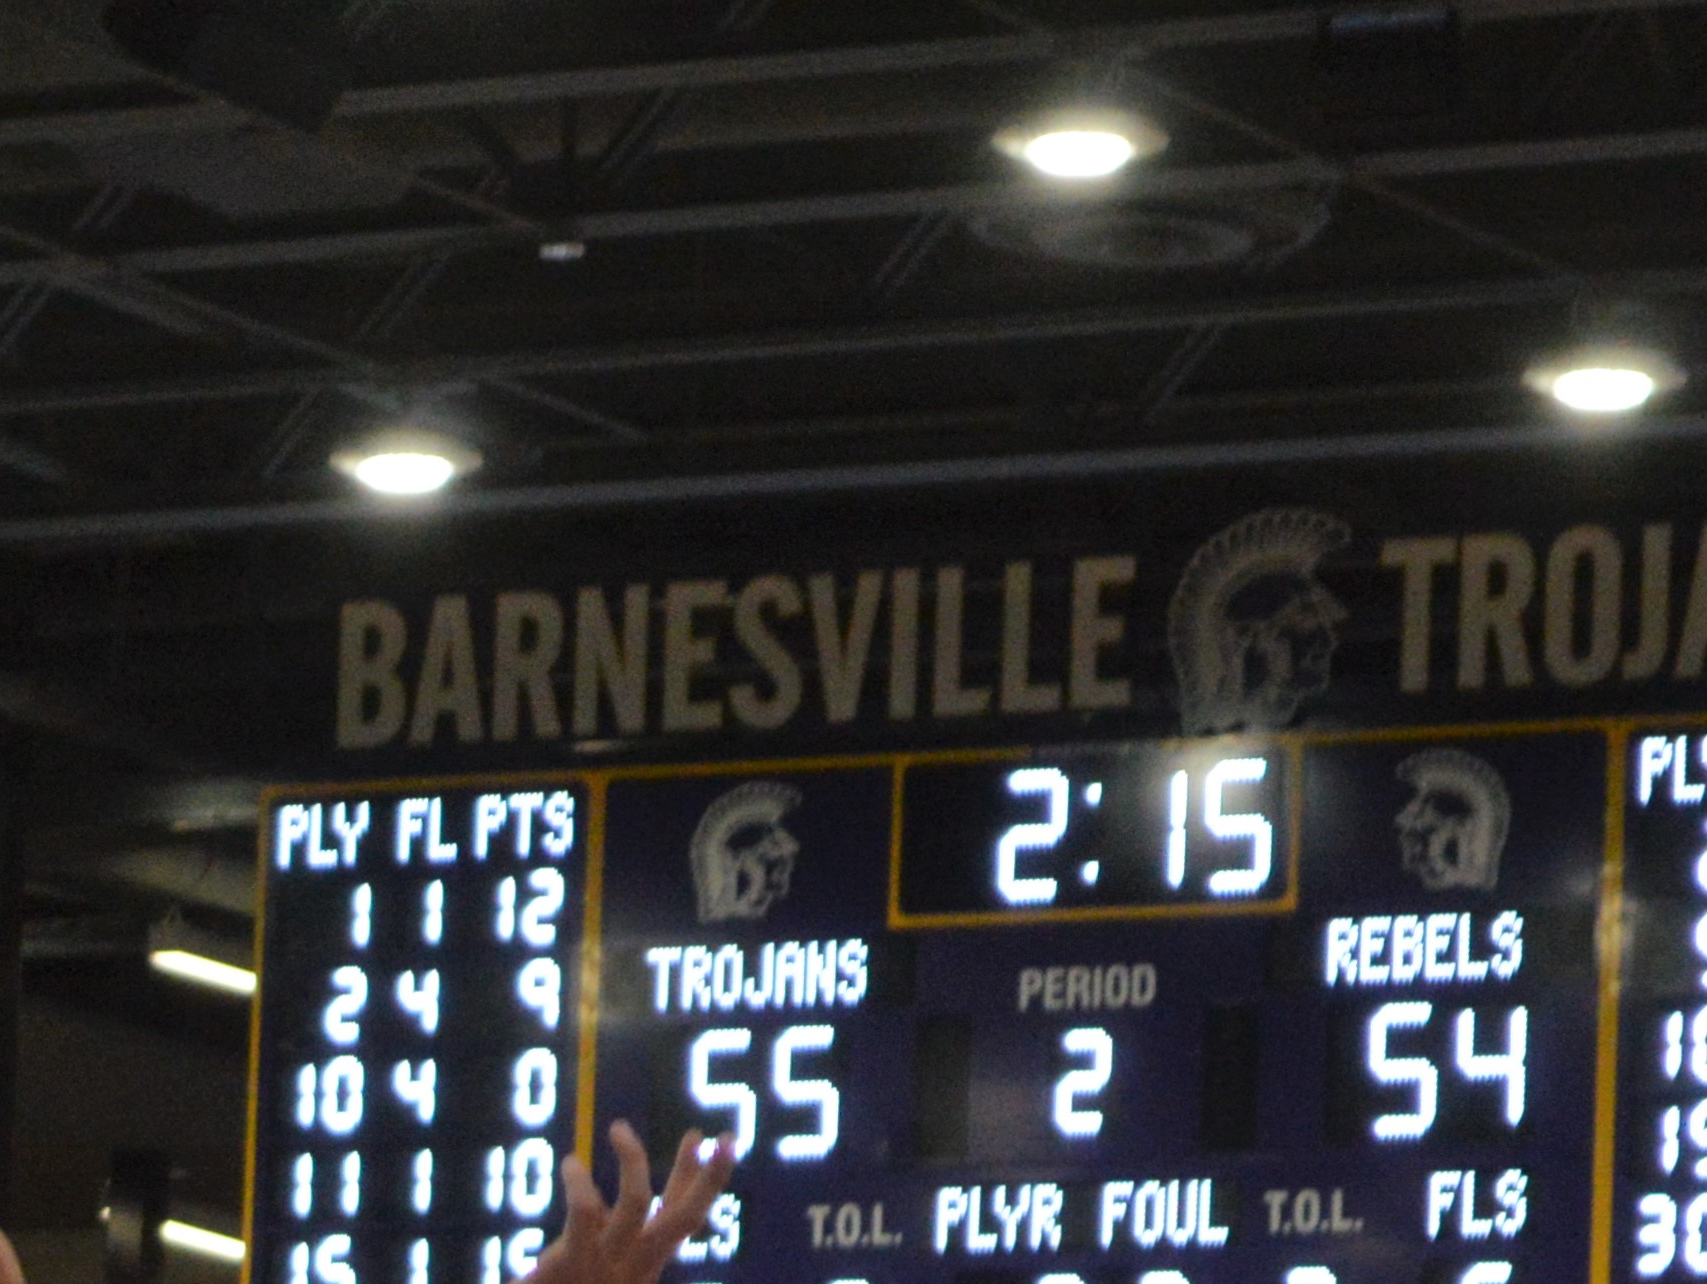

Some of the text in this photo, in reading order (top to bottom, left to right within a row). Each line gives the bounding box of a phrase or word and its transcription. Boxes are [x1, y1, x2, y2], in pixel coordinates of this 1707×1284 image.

[337, 558, 1134, 749] BARNESVILLE
[1639, 734, 1707, 806] PL
[276, 791, 574, 870] PLY FL PTS
[351, 867, 565, 948] 1 1 12
[645, 937, 868, 1013] TROJANS
[1018, 963, 1157, 1012] PERIOD
[1322, 910, 1524, 988] REBELS
[322, 957, 561, 1046] 2 4 9
[296, 1046, 559, 1136] 10 4 0
[689, 1024, 840, 1162] 55
[1053, 1026, 1113, 1138] 2
[1368, 1001, 1528, 1142] 54
[413, 1147, 433, 1216] 1
[487, 1137, 554, 1218] 10
[933, 1176, 1229, 1256] PLYR FOUL
[1263, 1188, 1364, 1235] T.O.L.
[1426, 1168, 1528, 1241] FLS
[807, 1203, 903, 1250] T.O.L.
